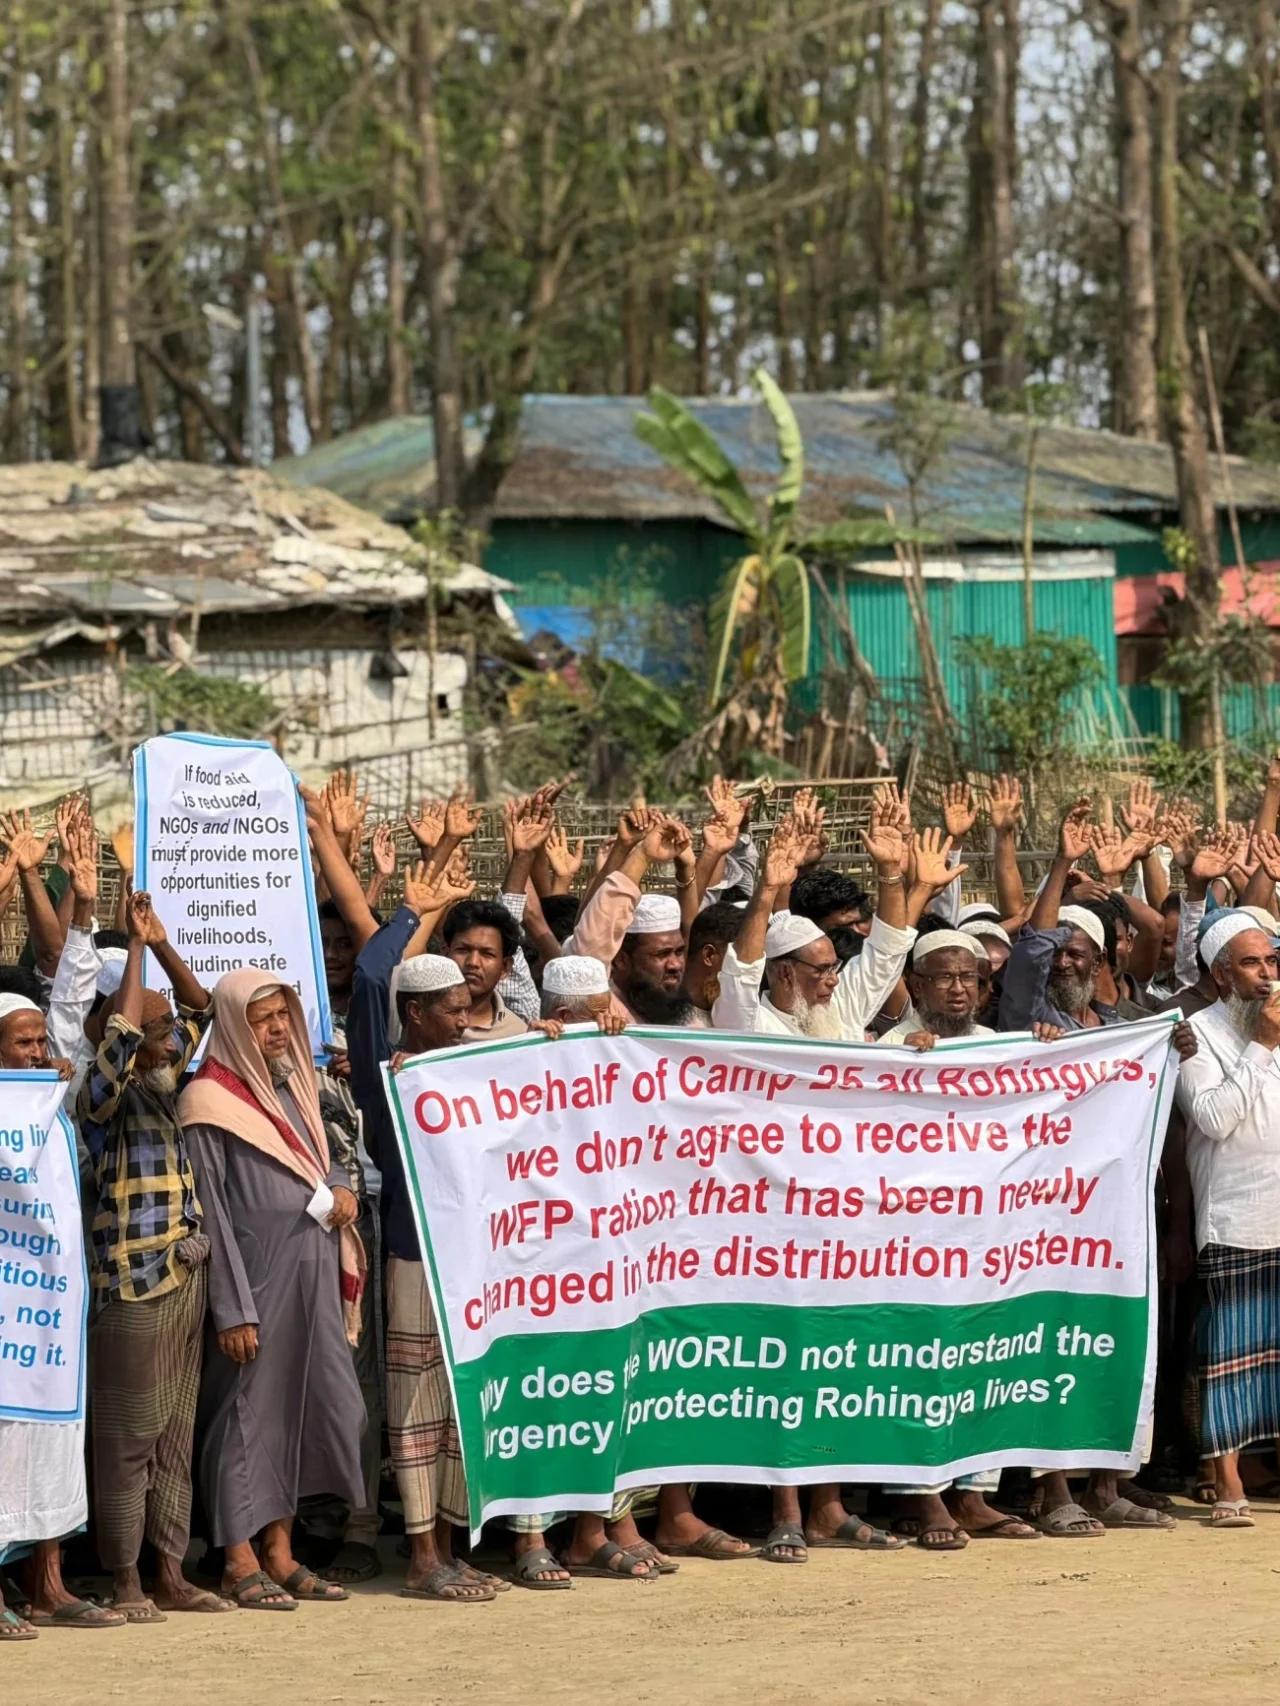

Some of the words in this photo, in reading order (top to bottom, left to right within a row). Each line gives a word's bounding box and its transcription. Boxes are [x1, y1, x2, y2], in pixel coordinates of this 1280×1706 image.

[185, 765, 193, 782] If
[196, 766, 221, 786] food
[224, 772, 250, 785] aid
[183, 791, 196, 808] is
[198, 791, 261, 810] reduced,
[160, 816, 198, 835] NGOs
[202, 818, 230, 835] and
[233, 817, 289, 835] INGOs
[152, 844, 188, 862] must
[190, 845, 247, 865] provide
[253, 847, 299, 862] more
[161, 872, 260, 893] opportunities
[265, 872, 292, 889] for
[187, 899, 257, 921] dignified
[177, 928, 273, 946] livelihoods,
[249, 953, 287, 971] safe
[414, 1090, 482, 1135] On
[489, 1062, 620, 1122] behalf
[632, 1057, 669, 1102] of
[679, 1055, 798, 1101] Camp
[29, 1124, 49, 1147] liv
[507, 1144, 558, 1182] we
[576, 1124, 668, 1174] don't
[676, 1121, 784, 1167] agree
[800, 1112, 842, 1154] to
[855, 1111, 1008, 1154] receive
[1022, 1112, 1072, 1147] the
[489, 1199, 574, 1252] WFP
[590, 1188, 676, 1239] ration
[688, 1176, 770, 1217] that
[784, 1176, 865, 1218] has
[878, 1176, 984, 1216] been
[998, 1166, 1100, 1215] newly
[464, 1260, 614, 1331] changed
[623, 1254, 642, 1297] in
[646, 1241, 700, 1285] the
[713, 1235, 968, 1280] distribution
[982, 1228, 1124, 1285] system.
[17, 1305, 63, 1330] not
[46, 1342, 67, 1367] it.
[521, 1366, 615, 1399] does
[648, 1336, 787, 1373] WORLD
[801, 1338, 857, 1371] not
[868, 1322, 1045, 1371] understand
[1056, 1325, 1115, 1357] the
[626, 1385, 804, 1435] protecting
[814, 1385, 975, 1428] Rohingya
